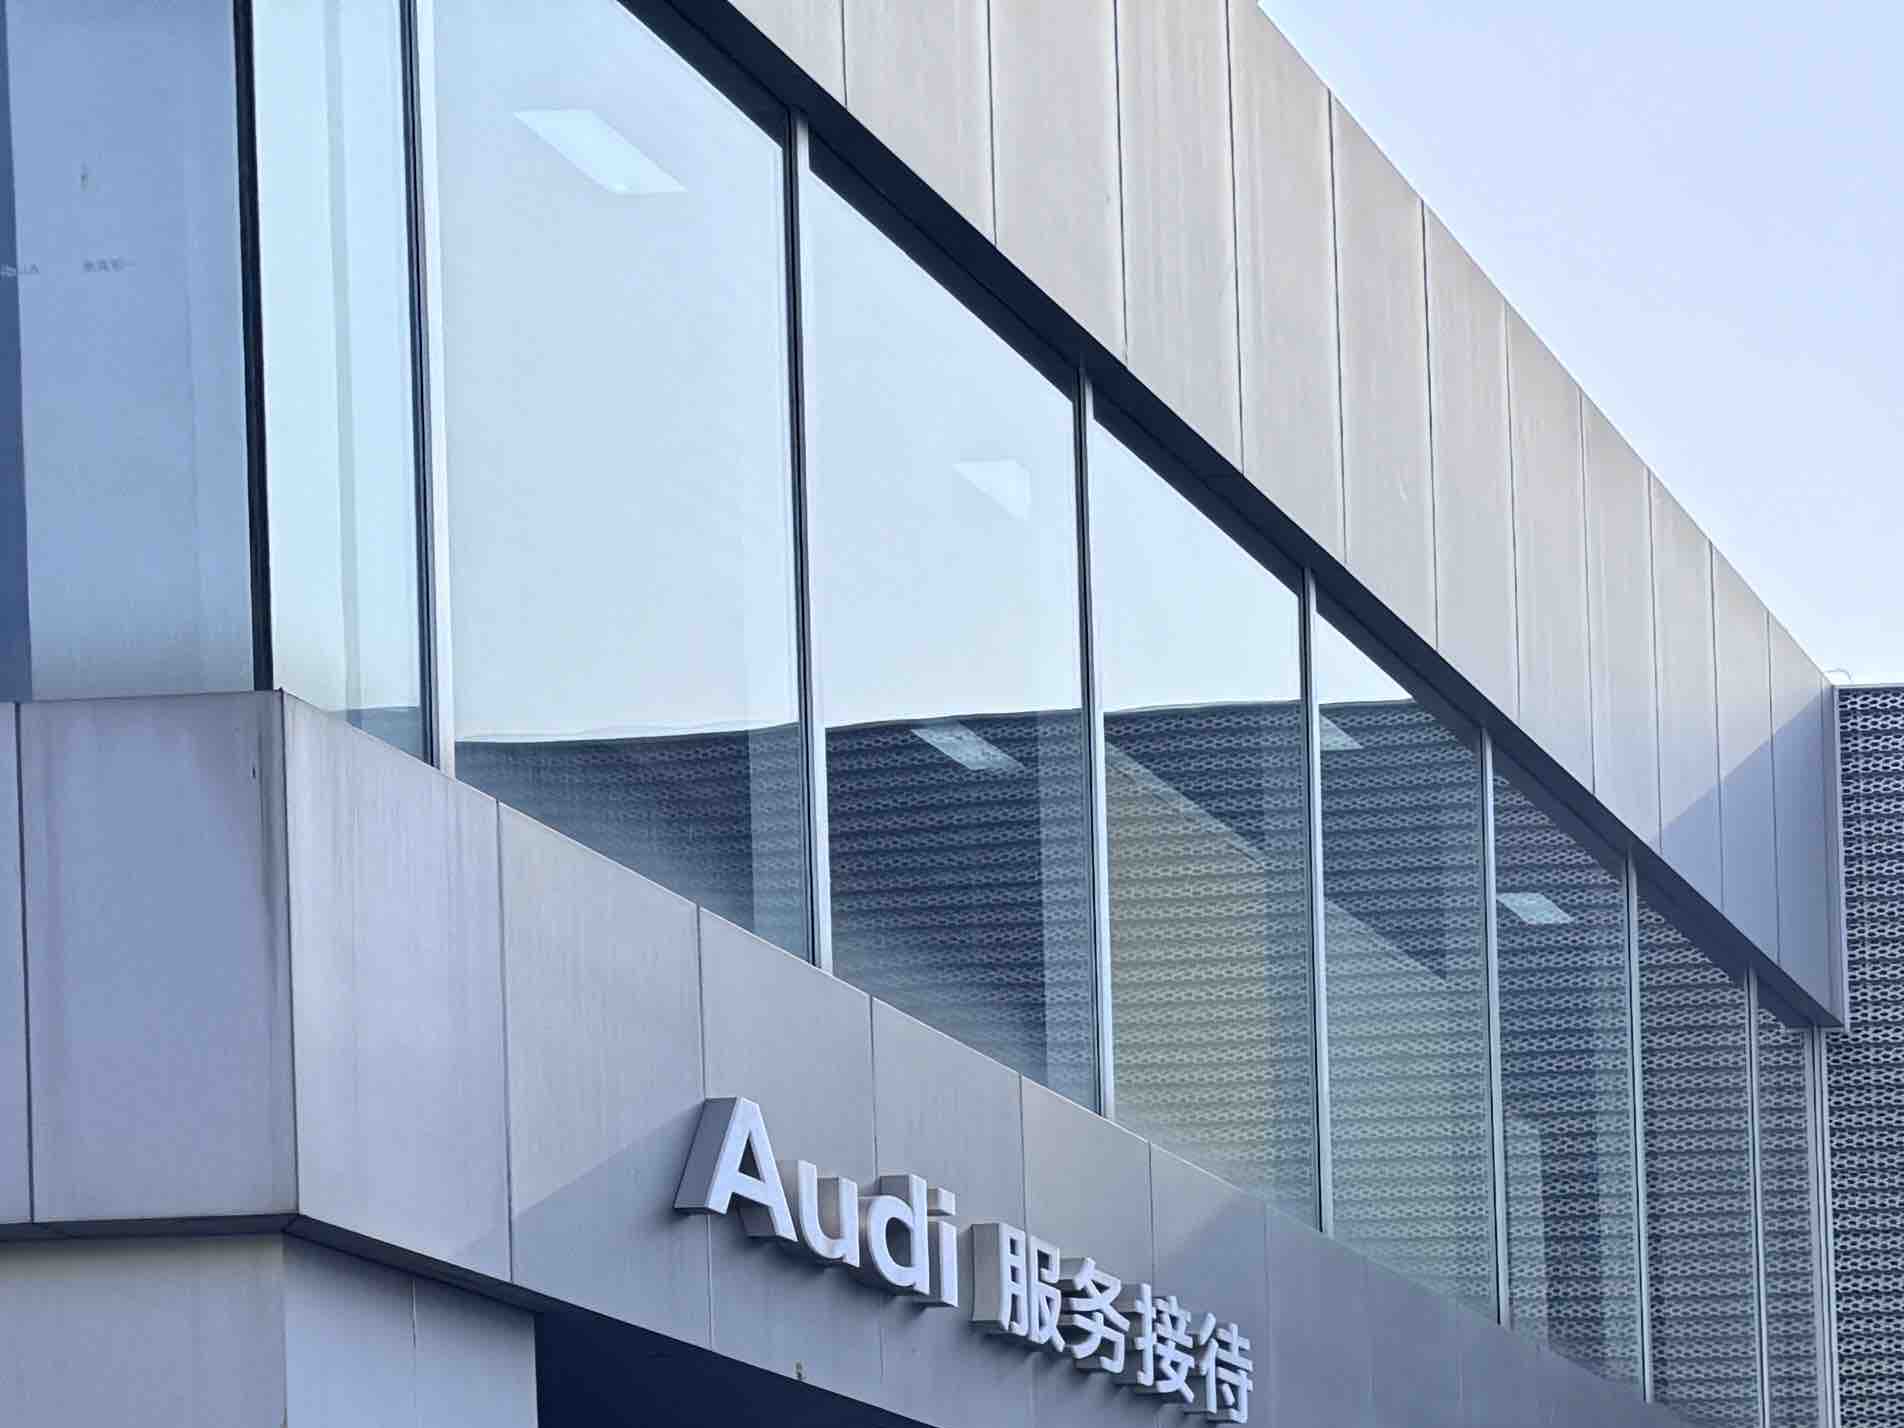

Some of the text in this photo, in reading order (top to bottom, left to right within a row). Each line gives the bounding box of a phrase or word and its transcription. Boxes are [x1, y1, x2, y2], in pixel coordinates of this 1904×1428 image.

[700, 1097, 1253, 1423] Audi 服务接待
